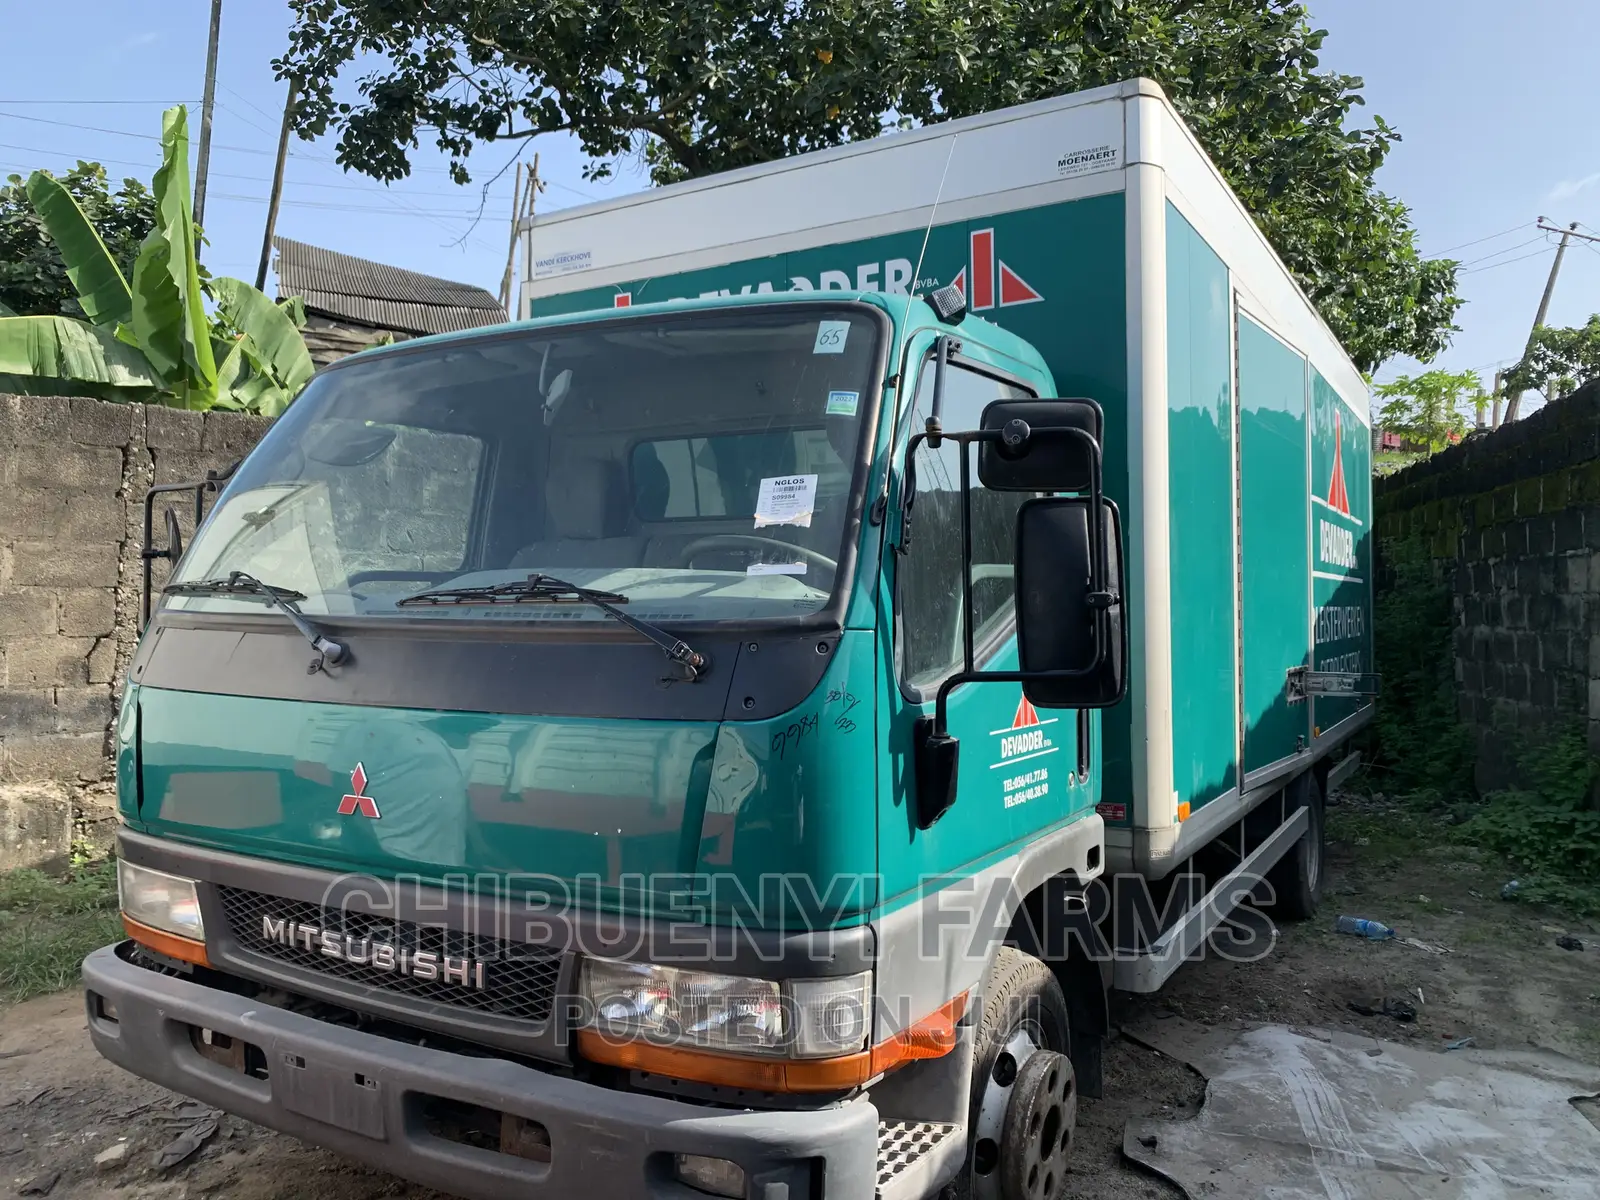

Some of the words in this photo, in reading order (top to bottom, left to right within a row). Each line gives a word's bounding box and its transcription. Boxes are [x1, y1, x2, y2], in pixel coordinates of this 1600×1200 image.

[1058, 149, 1117, 167] MOENAERT
[1064, 145, 1110, 158] CARROSSERIE
[556, 251, 591, 263] KERCKHOVE
[915, 278, 939, 290] BVBA
[819, 328, 844, 345] 65
[774, 478, 805, 486] NGLOS
[1320, 518, 1354, 569] DEVADDER
[1001, 730, 1043, 759] DEVADDER
[262, 915, 485, 991] MITSUBISHI
